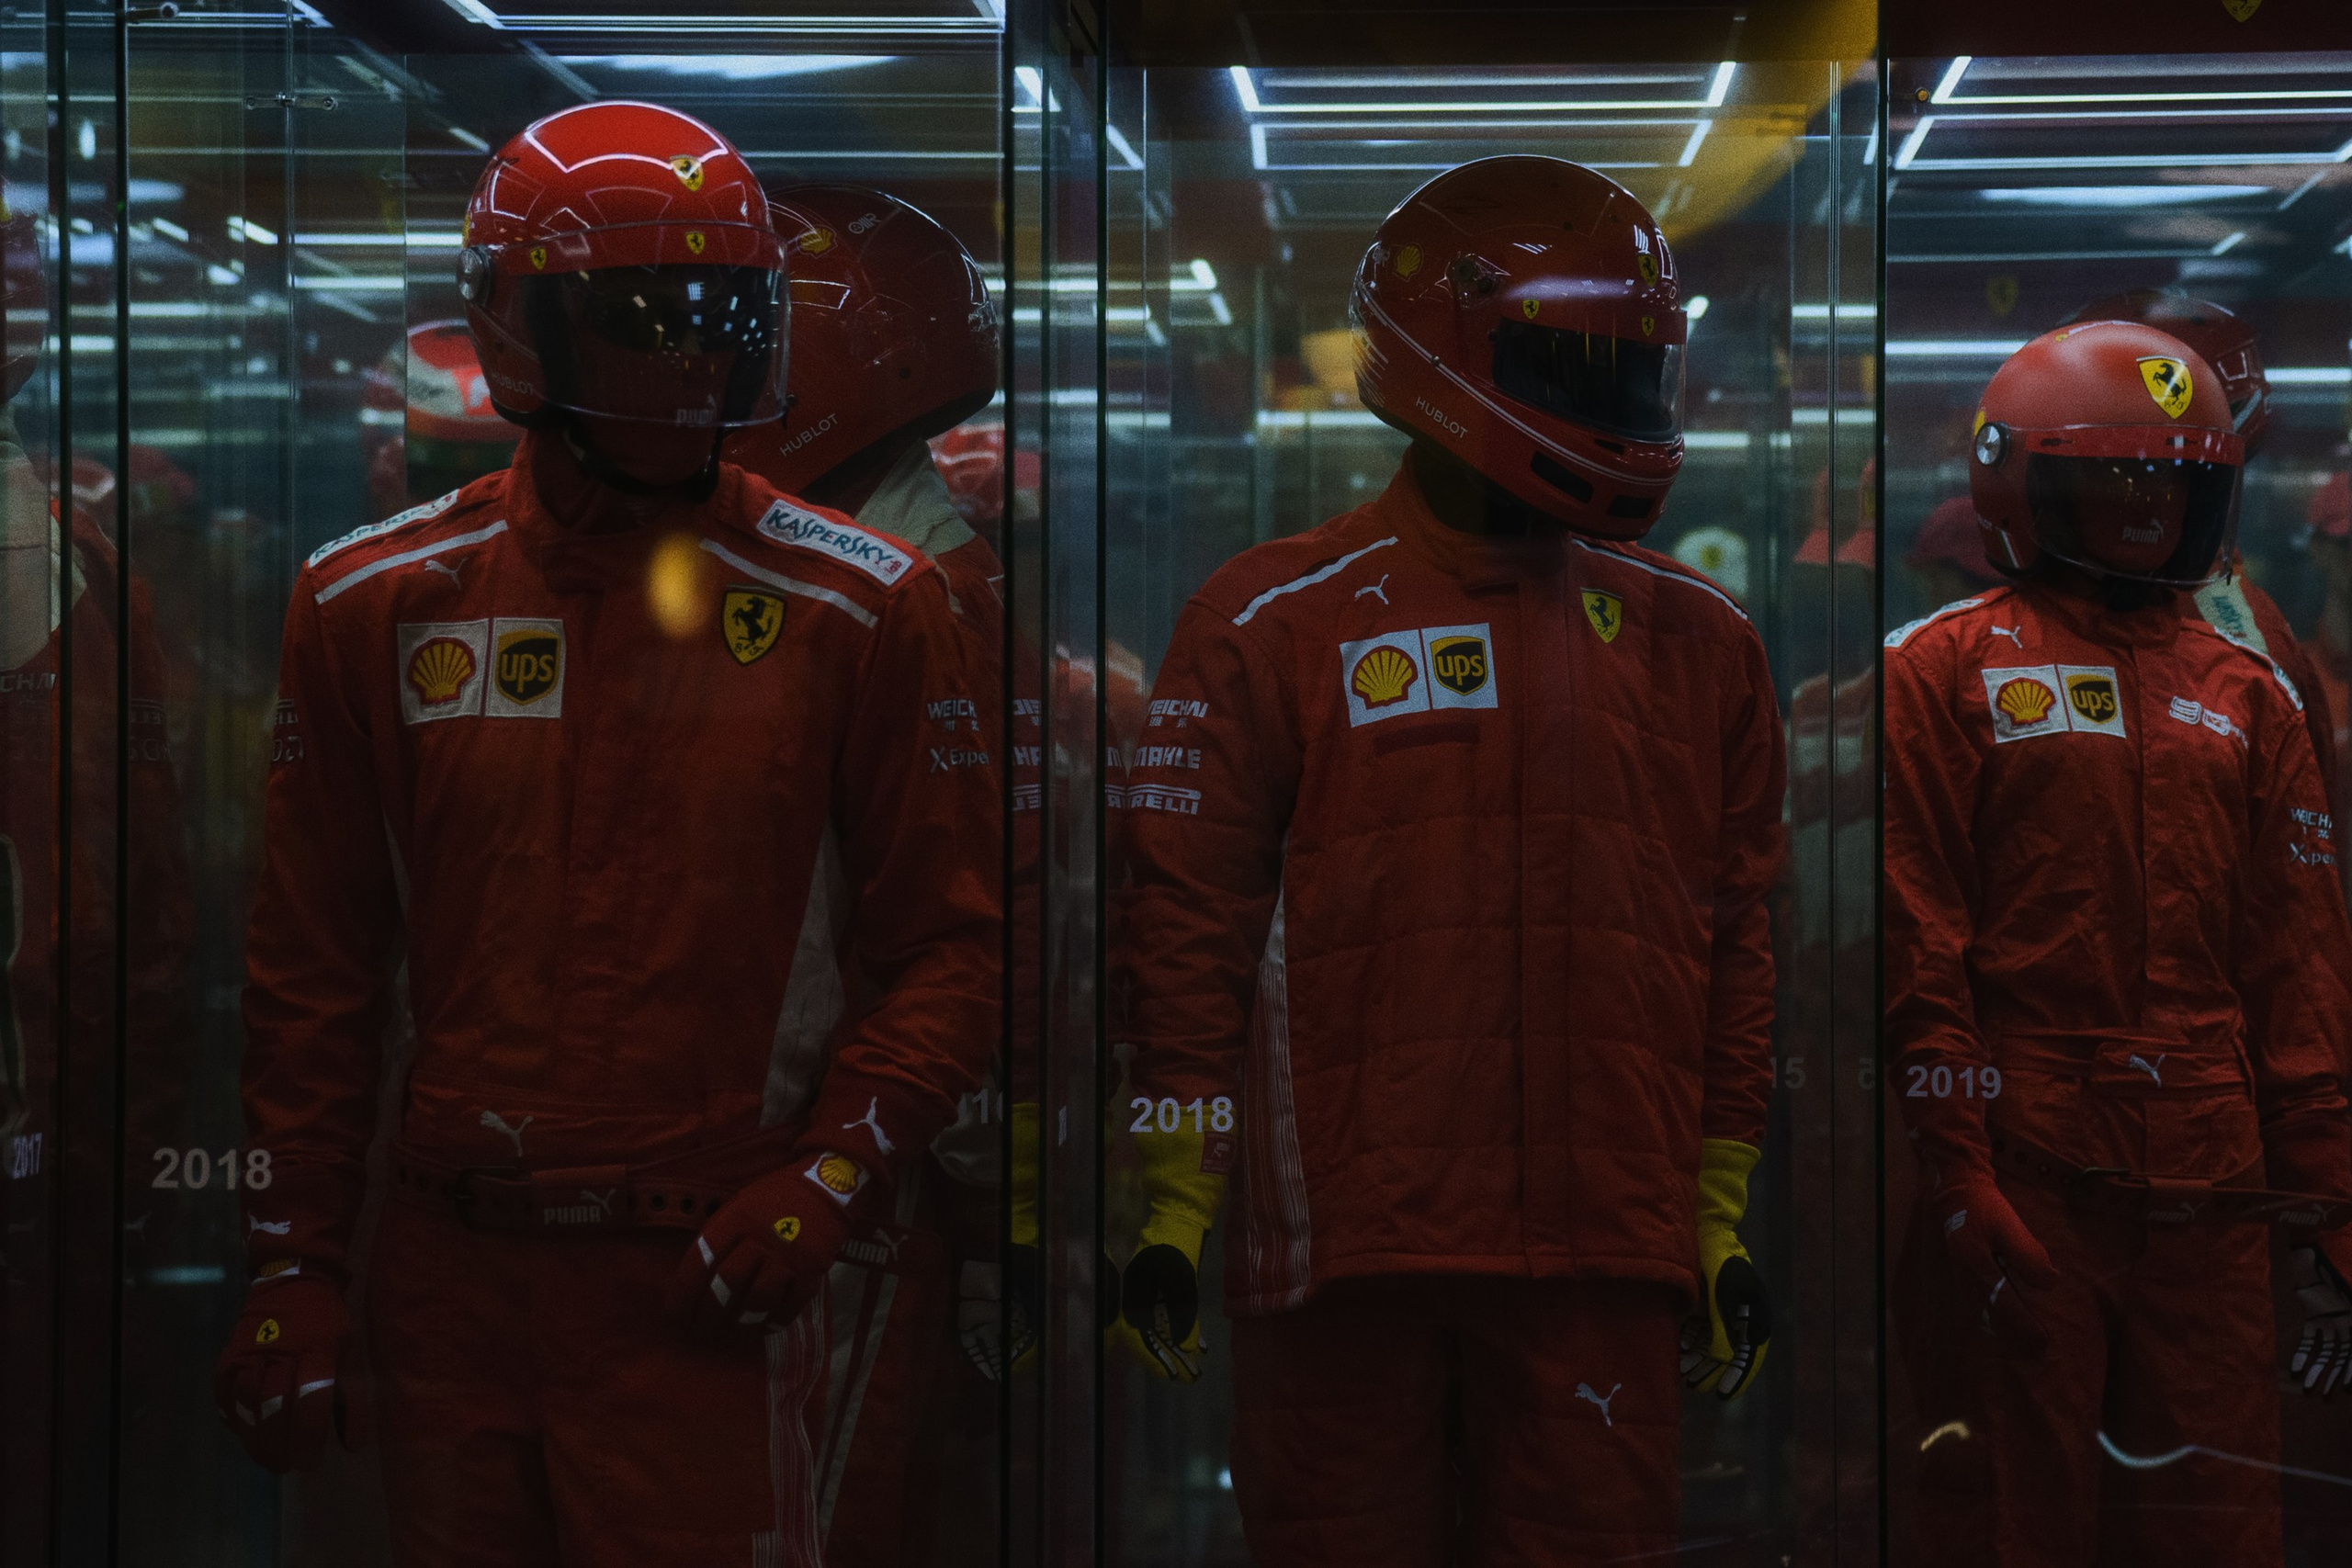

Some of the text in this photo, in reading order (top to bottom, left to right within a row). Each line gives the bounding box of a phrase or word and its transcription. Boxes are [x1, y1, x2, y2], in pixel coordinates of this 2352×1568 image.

[780, 412, 838, 457] HUBLOT
[1415, 396, 1468, 439] HUBLOT
[767, 509, 893, 565] KASPERSKY
[501, 653, 555, 694] ups
[1437, 654, 1485, 687] ups
[2072, 689, 2114, 717] ups
[1905, 1065, 2002, 1099] 2019
[1129, 1096, 1234, 1134] 2018
[11, 1132, 43, 1180] 2017
[151, 1147, 273, 1190] 2018
[544, 1205, 601, 1225] PUMA
